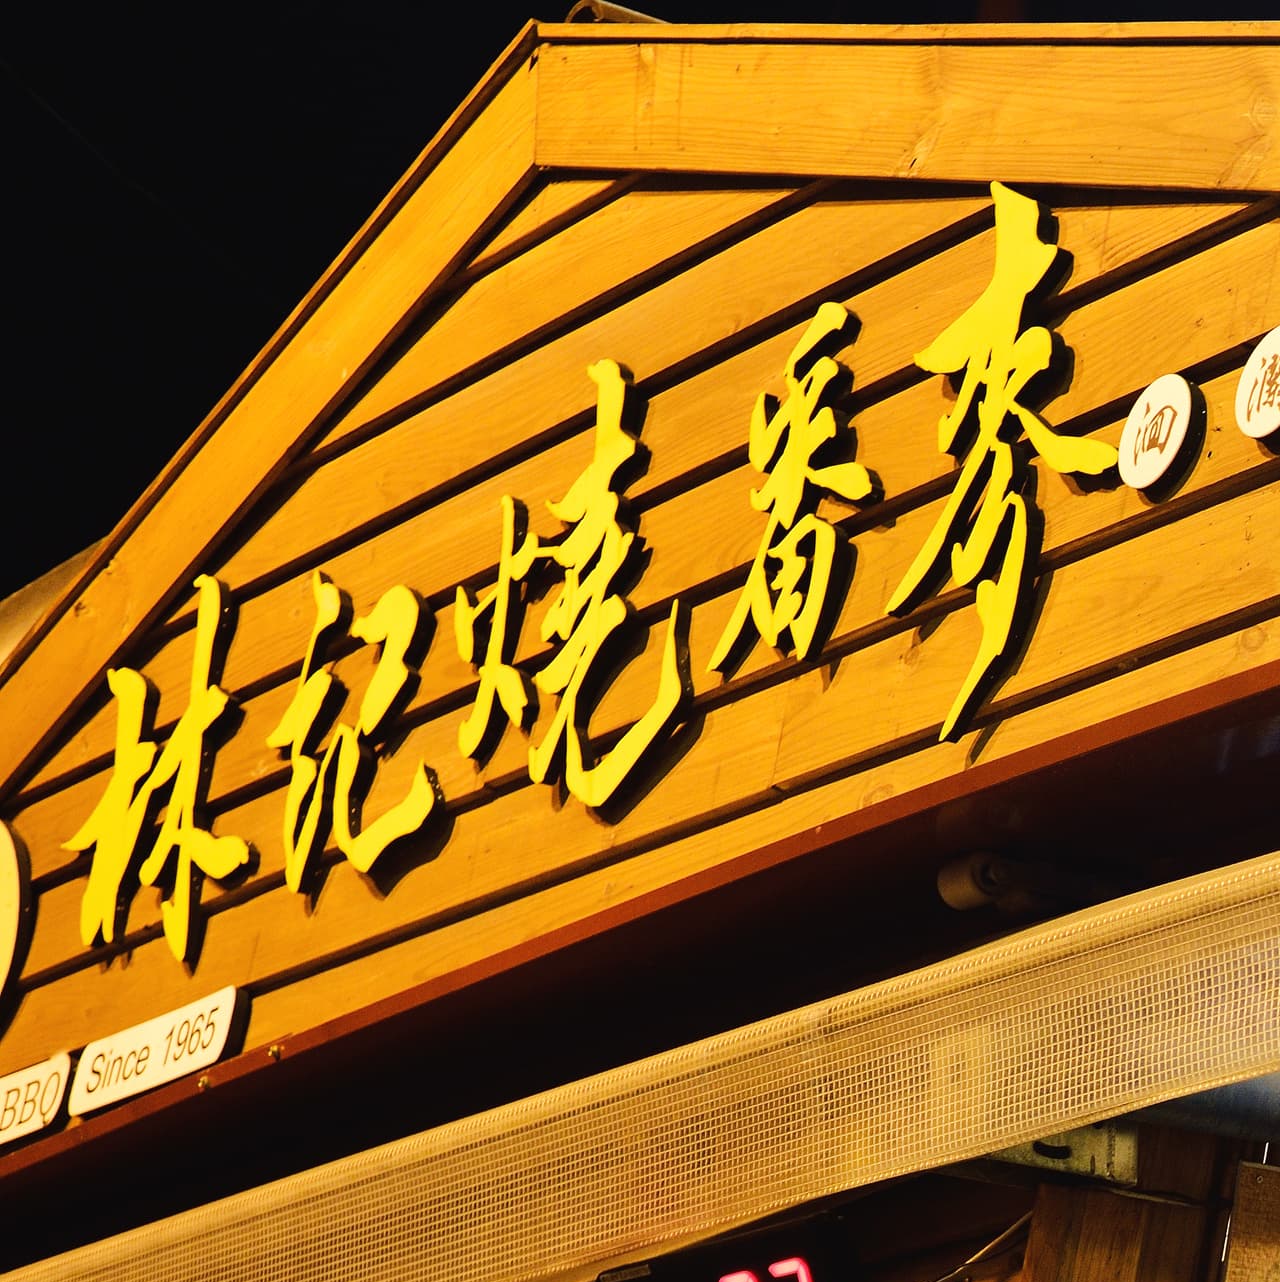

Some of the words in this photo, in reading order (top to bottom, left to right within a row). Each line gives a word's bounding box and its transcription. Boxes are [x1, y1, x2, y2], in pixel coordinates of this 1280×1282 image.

[86, 1045, 150, 1093] Since
[162, 1006, 220, 1067] 1965
[0, 1071, 61, 1132] BBQ
